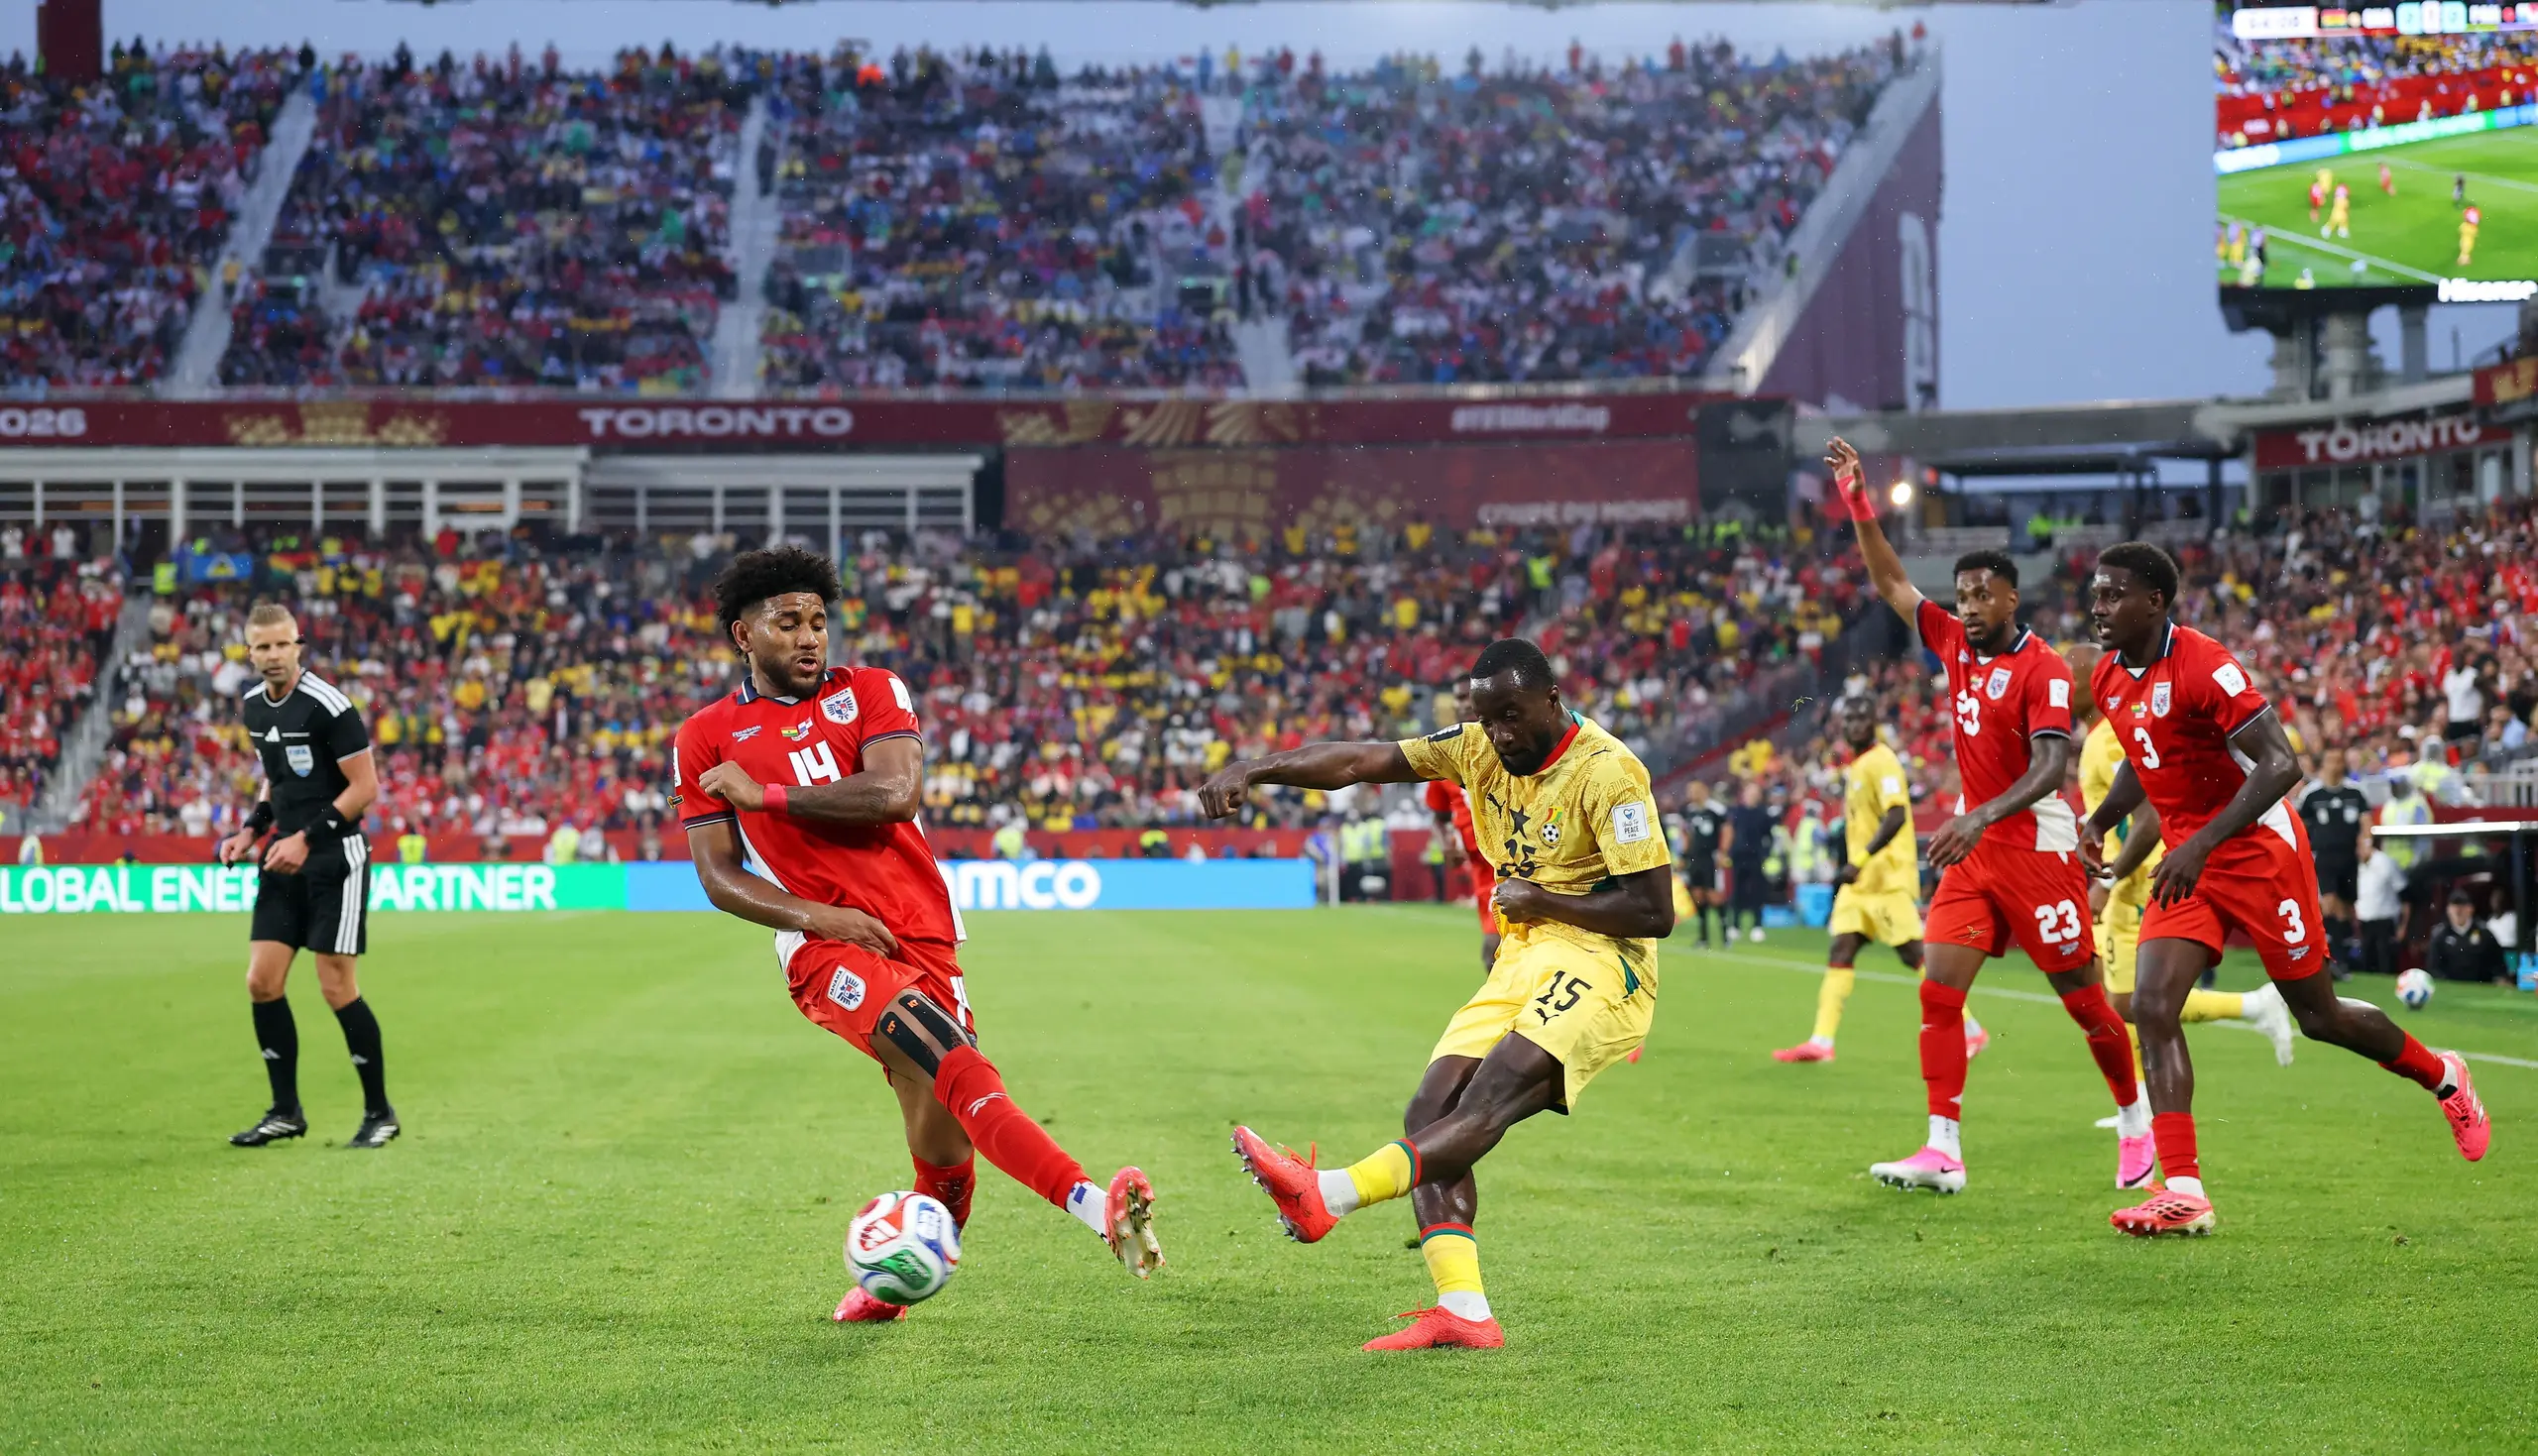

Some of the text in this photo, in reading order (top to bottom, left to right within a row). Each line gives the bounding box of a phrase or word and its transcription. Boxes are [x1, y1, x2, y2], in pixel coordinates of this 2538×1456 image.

[578, 407, 853, 437] TORONTO
[732, 725, 761, 737] Reebok
[2134, 727, 2160, 770] 3
[788, 740, 841, 786] 14
[1624, 826, 1640, 835] PEACE
[370, 865, 557, 911] ARTNER
[2034, 899, 2081, 944] 23
[2278, 898, 2306, 944] 3
[829, 970, 843, 996] PANAMA
[1535, 970, 1593, 1012] 15
